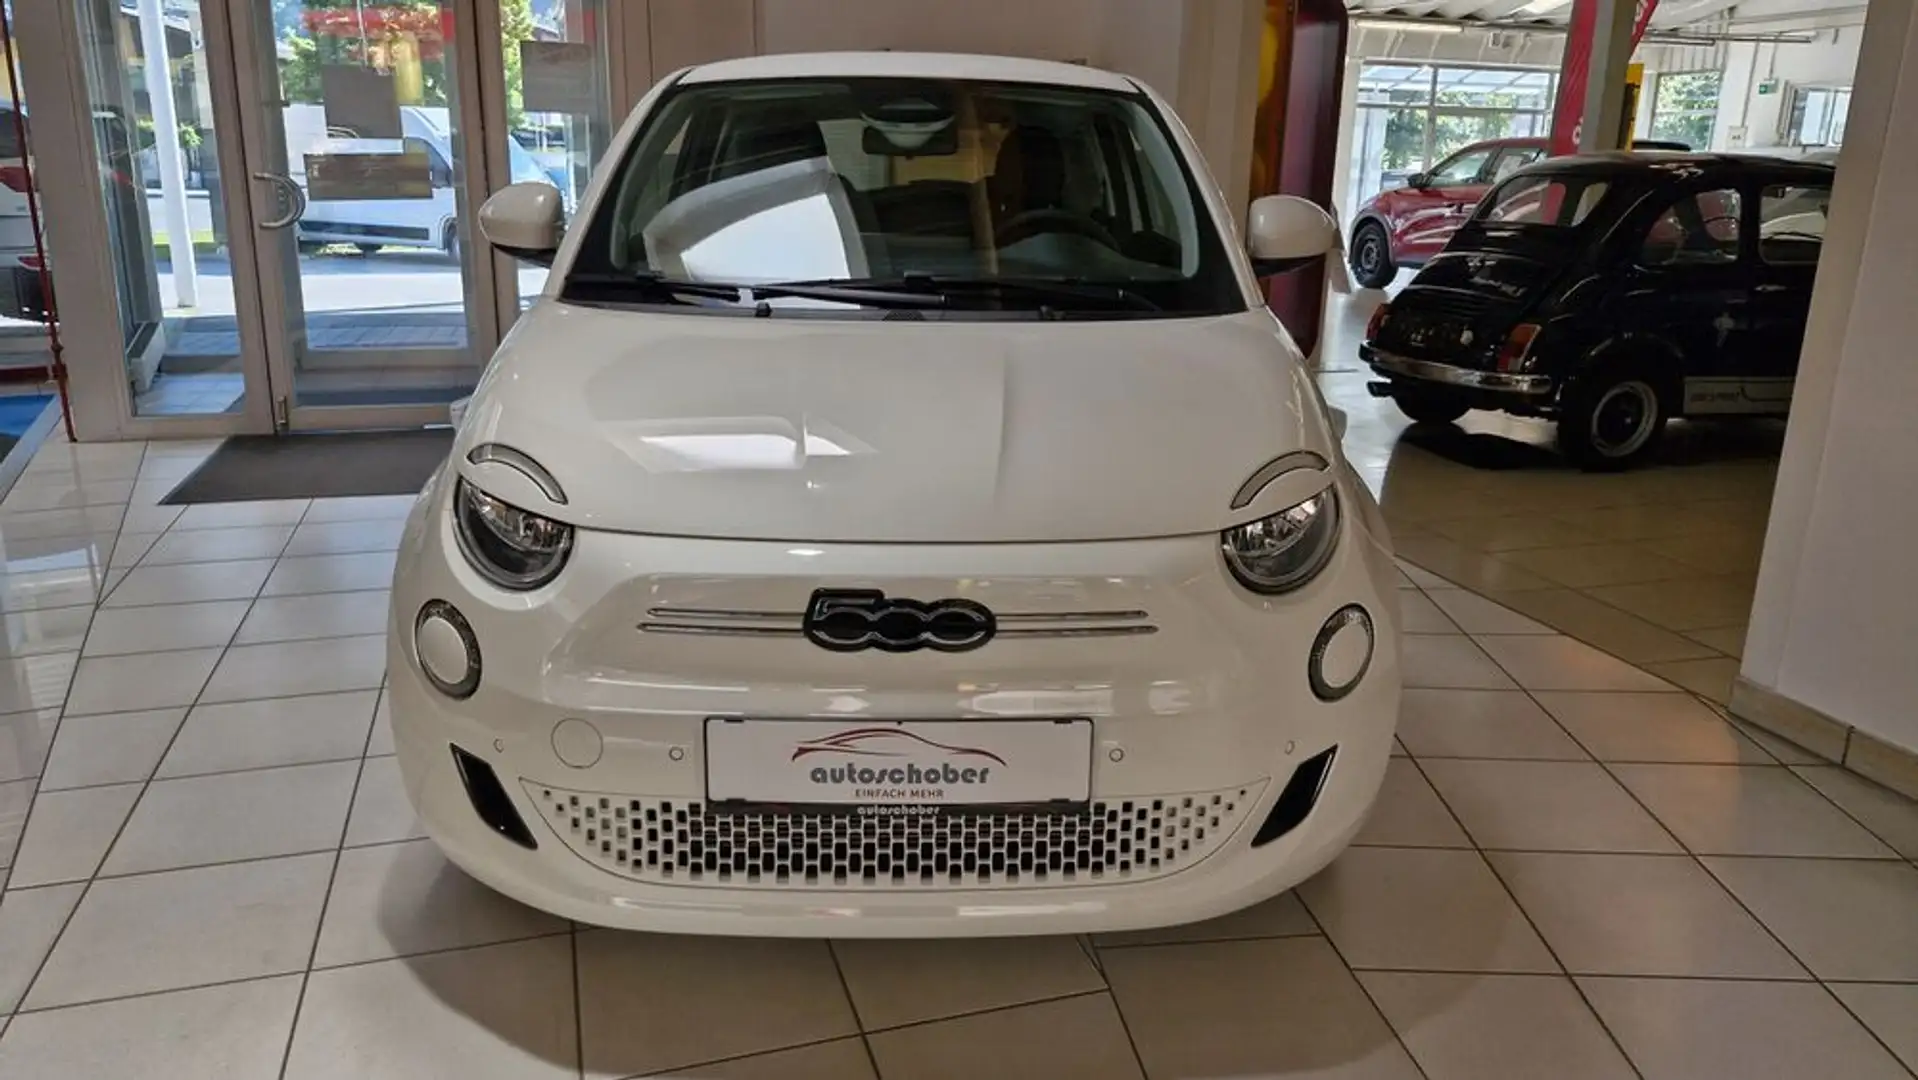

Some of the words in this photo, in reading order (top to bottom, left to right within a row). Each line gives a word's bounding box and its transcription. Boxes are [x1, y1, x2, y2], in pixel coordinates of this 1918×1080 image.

[804, 588, 996, 652] 500
[810, 762, 990, 784] autoschober
[855, 788, 905, 799] EINFACH
[910, 788, 944, 799] MEHR
[857, 804, 941, 815] autoschober
